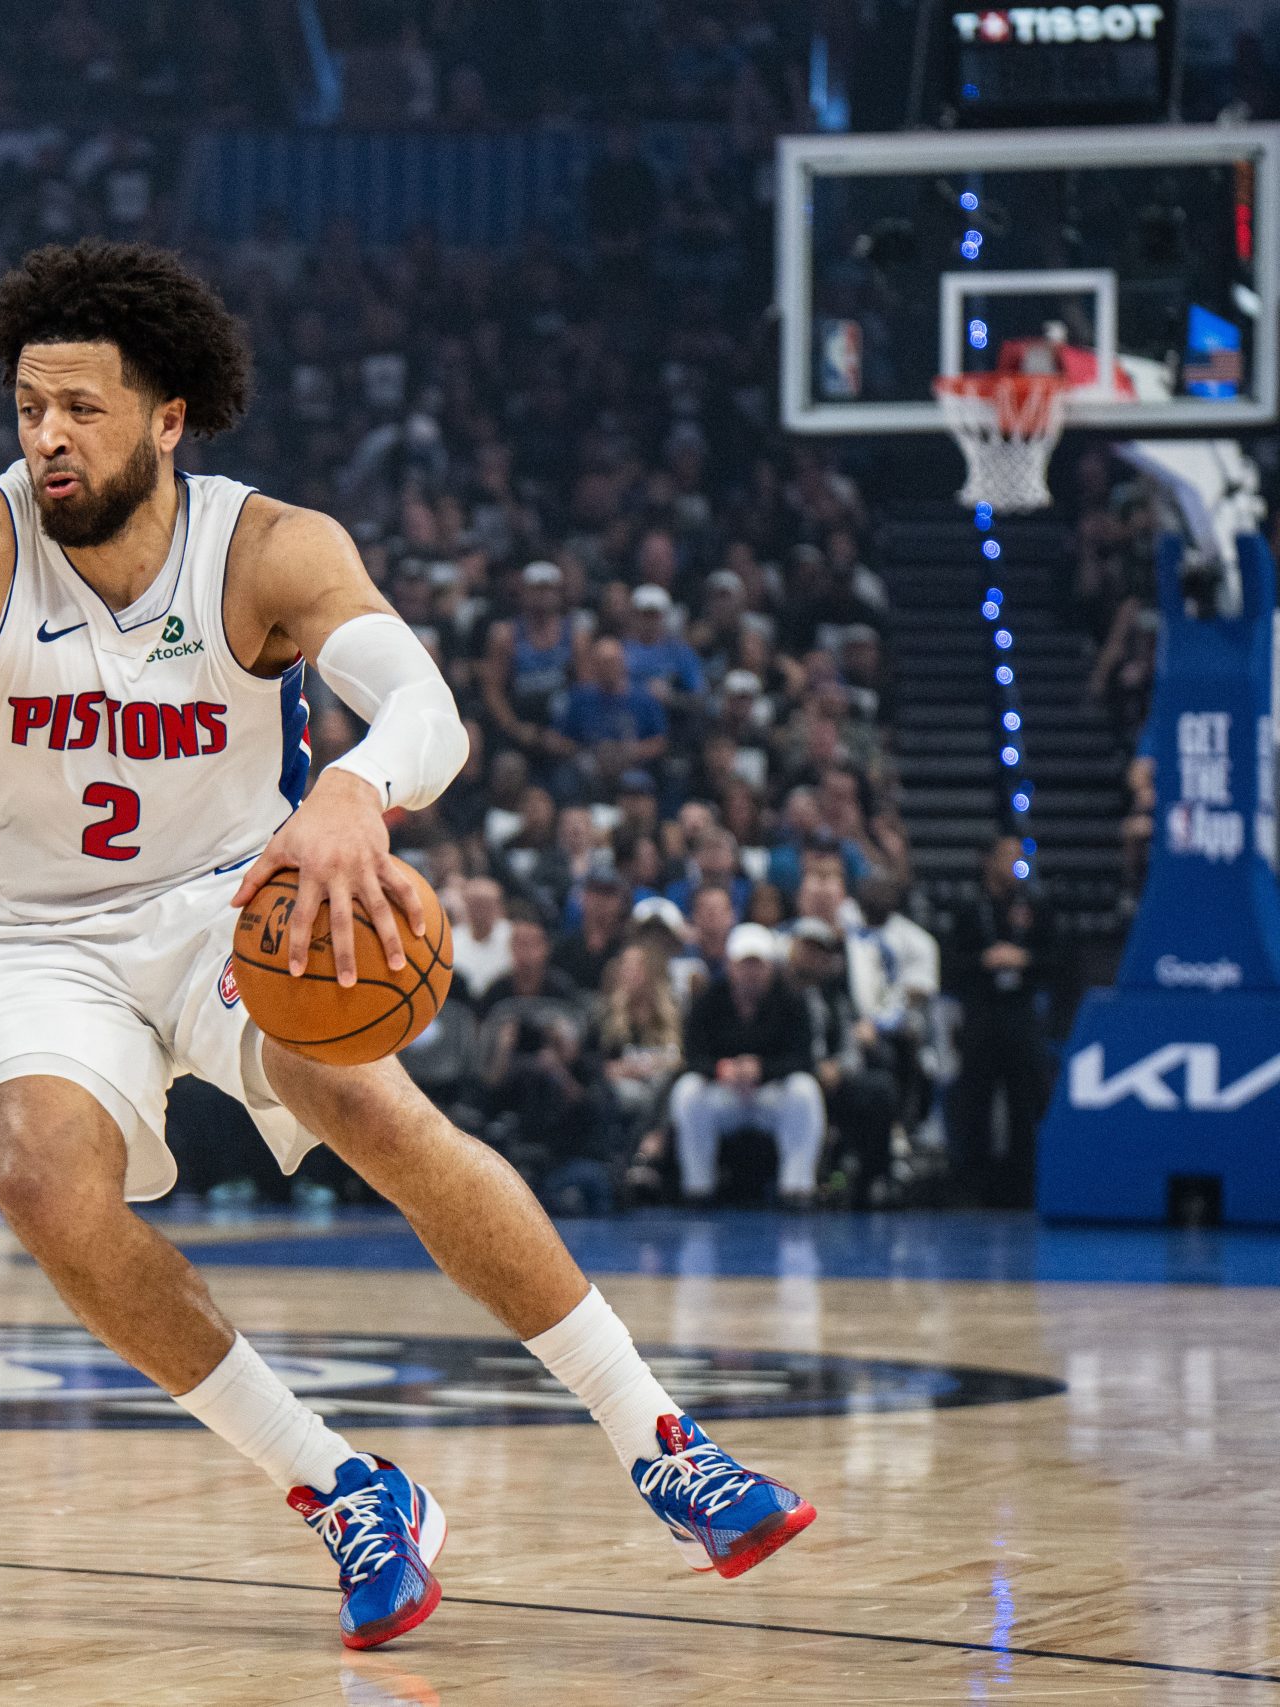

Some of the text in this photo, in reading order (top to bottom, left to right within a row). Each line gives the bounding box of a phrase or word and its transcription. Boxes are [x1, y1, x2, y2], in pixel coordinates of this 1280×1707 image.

[1007, 3, 1164, 44] TISSOT
[8, 690, 228, 760] PISTONS
[81, 781, 141, 862] 2
[1154, 953, 1243, 991] Google
